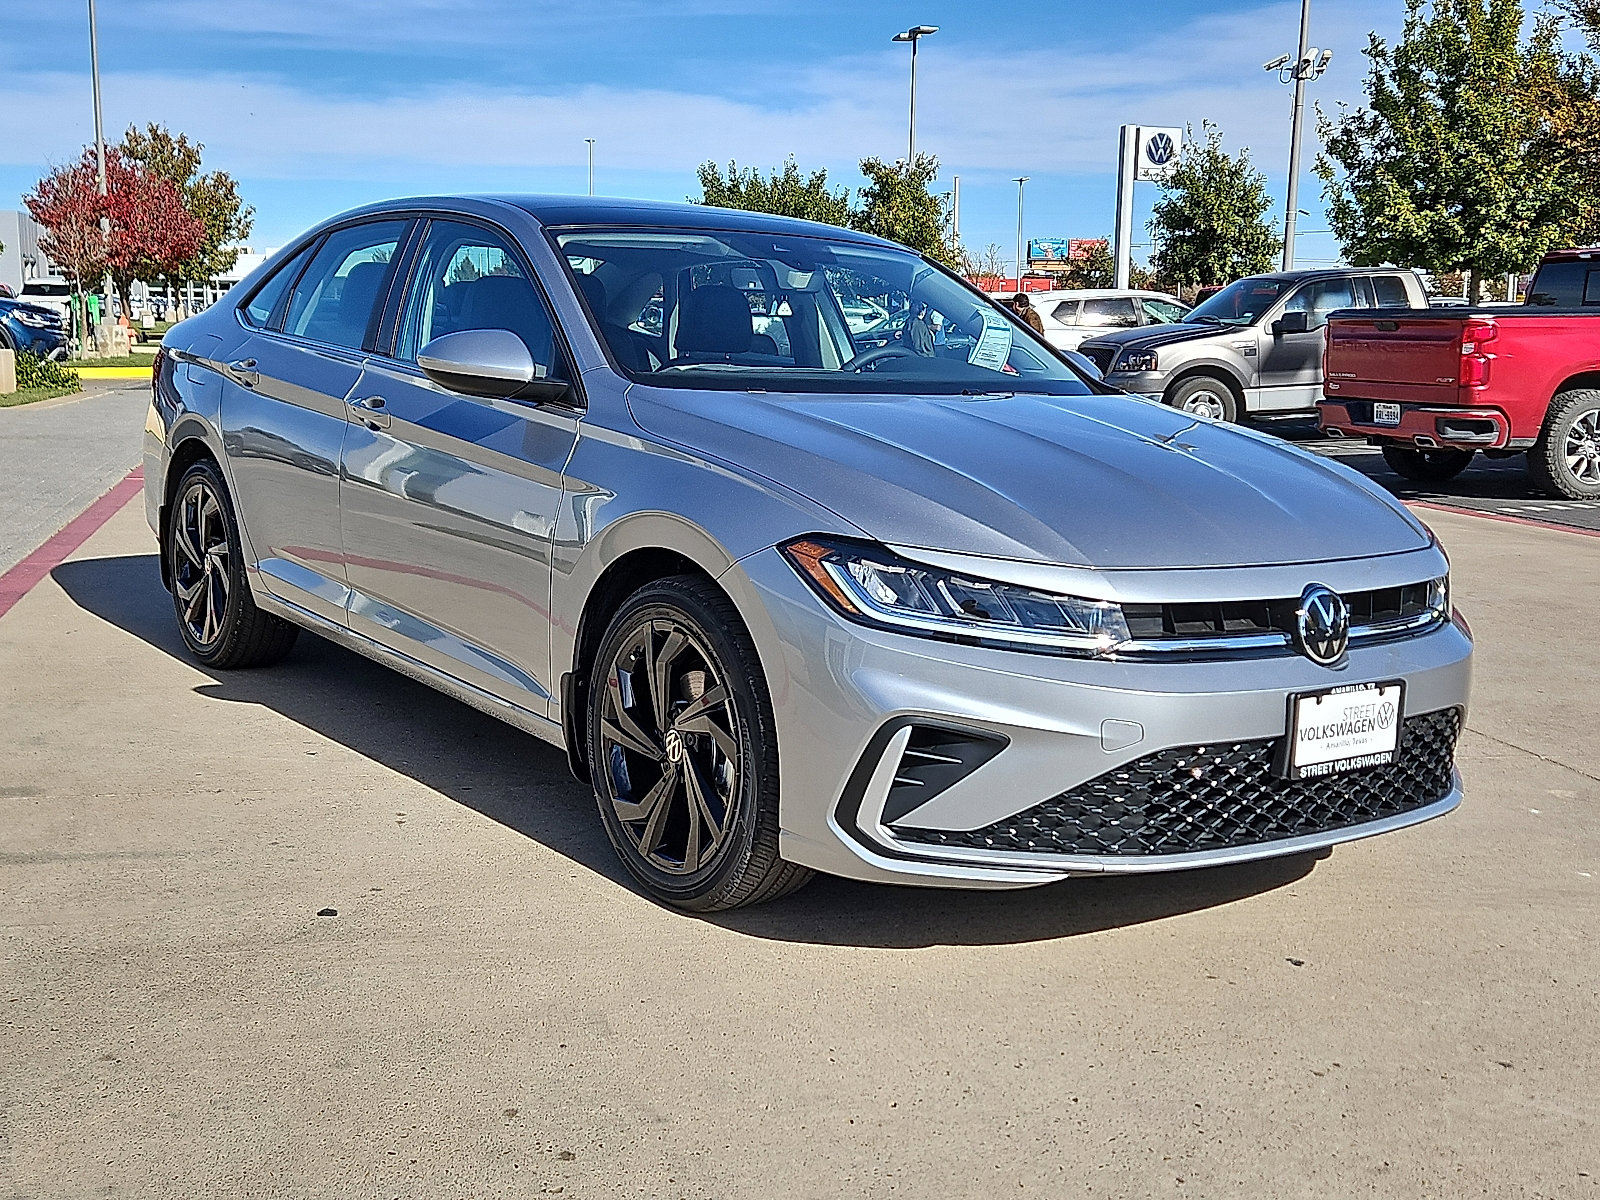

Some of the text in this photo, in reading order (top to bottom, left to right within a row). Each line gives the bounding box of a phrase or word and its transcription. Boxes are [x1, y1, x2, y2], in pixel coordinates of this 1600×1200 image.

[1146, 133, 1173, 165] VW
[1299, 717, 1376, 742] VOLKSWAGEN
[1342, 701, 1394, 730] STREET VW
[1299, 751, 1393, 779] STREET VOLKSWAGEN
